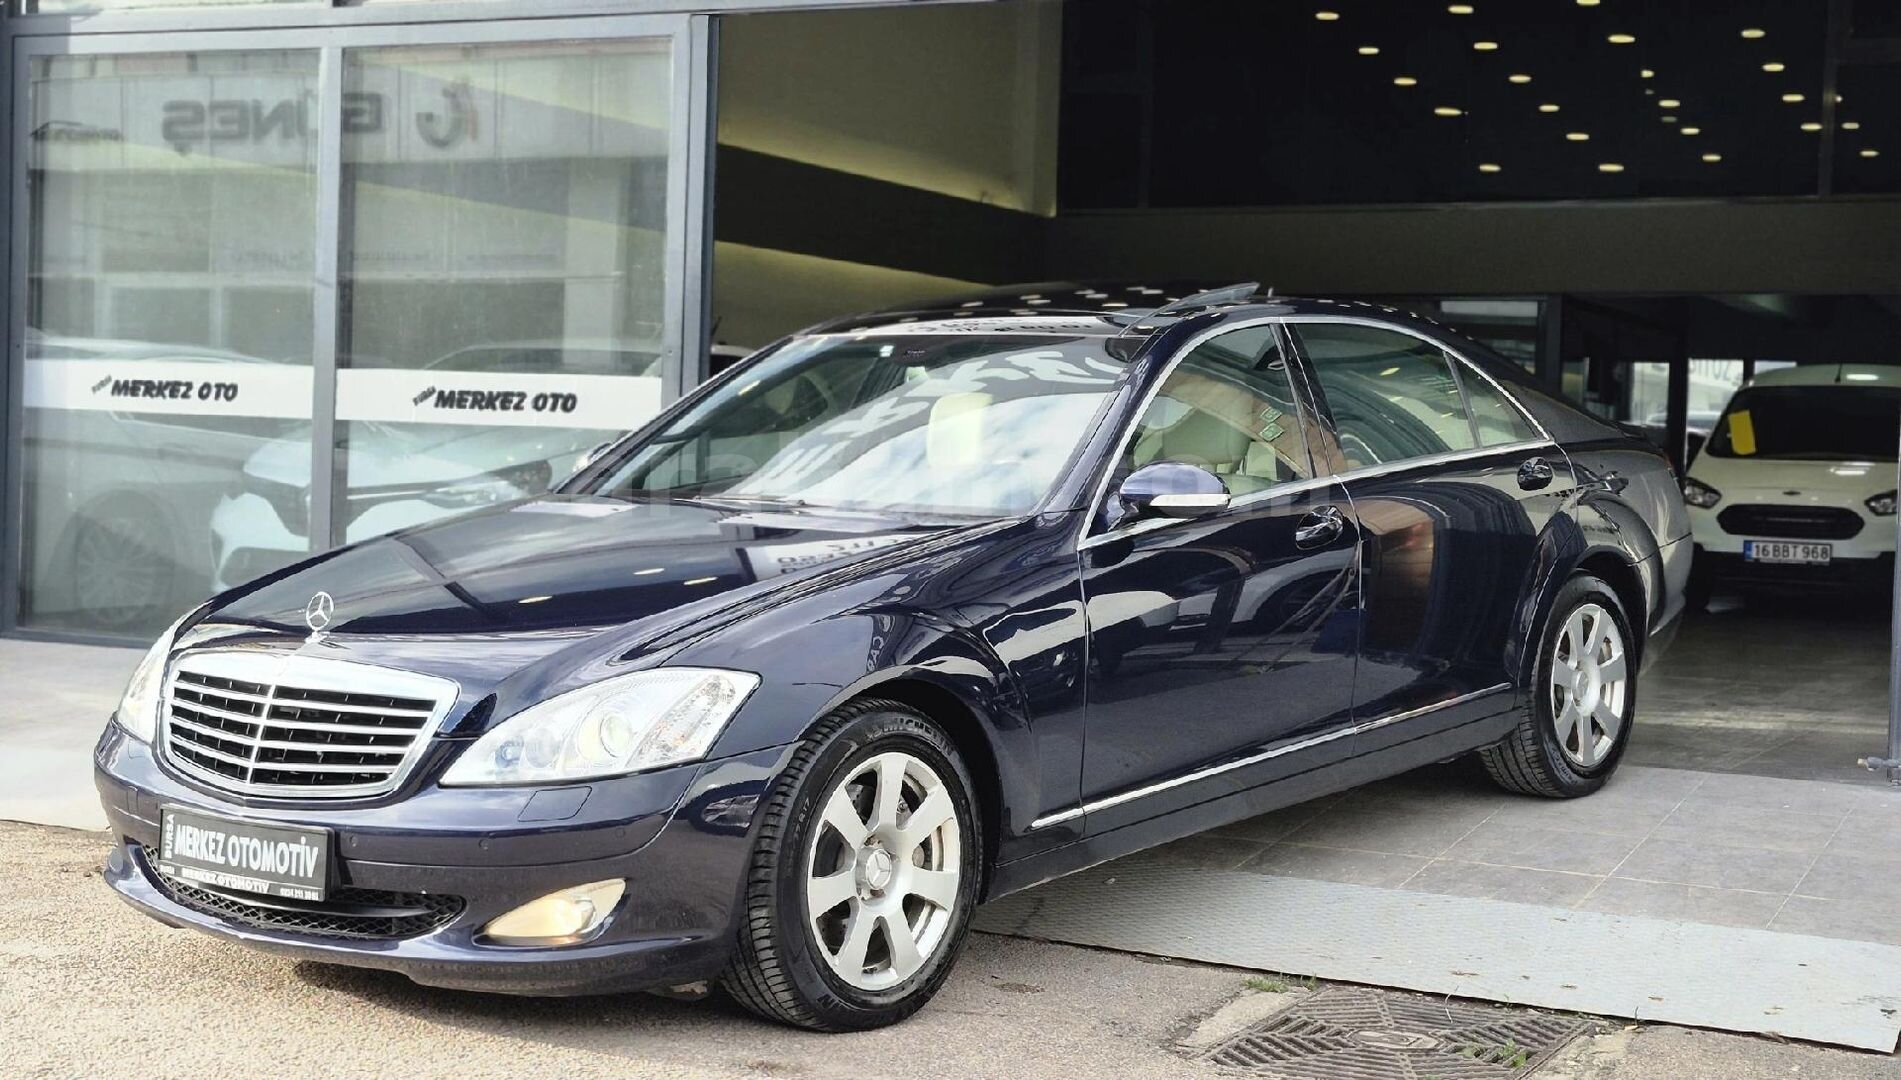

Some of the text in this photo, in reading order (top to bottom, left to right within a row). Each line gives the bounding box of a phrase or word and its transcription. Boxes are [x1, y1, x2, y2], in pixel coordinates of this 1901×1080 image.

[111, 379, 239, 401] MERKEZ OTO
[434, 390, 578, 413] MERKEZ OTO
[1755, 544, 1829, 560] 16 BBT 968
[174, 824, 319, 878] MERKEZ OTOMOTİV
